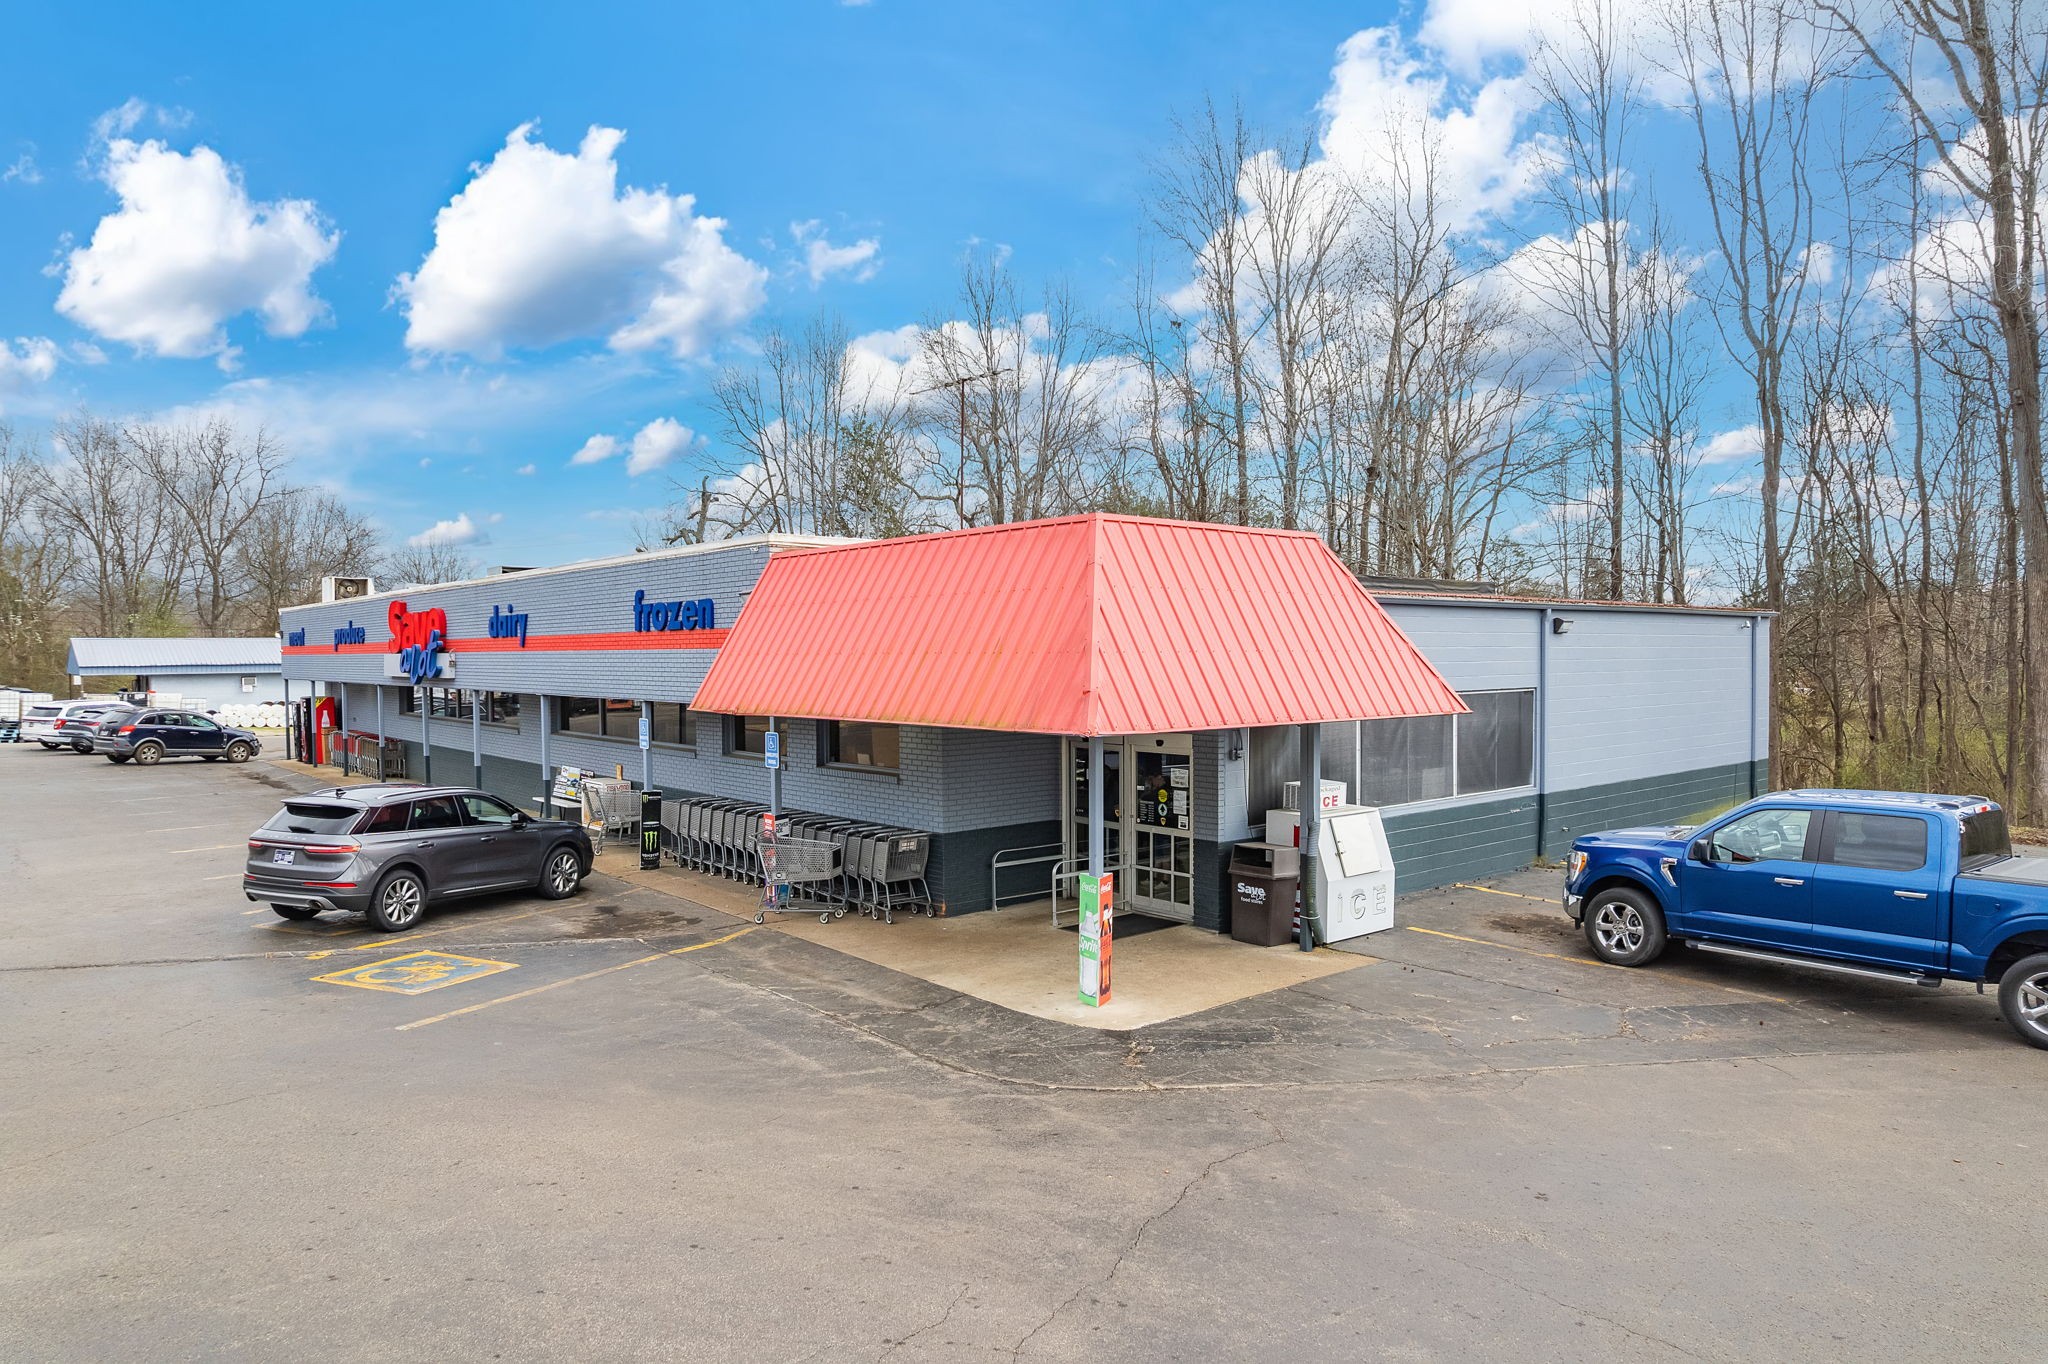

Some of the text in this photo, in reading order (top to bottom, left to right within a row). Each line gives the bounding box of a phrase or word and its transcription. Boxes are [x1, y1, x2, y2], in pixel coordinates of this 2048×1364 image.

[388, 600, 447, 653] Save
[488, 604, 528, 648] dairy
[633, 589, 714, 632] frozen
[334, 620, 365, 652] produce
[1237, 882, 1265, 897] Save
